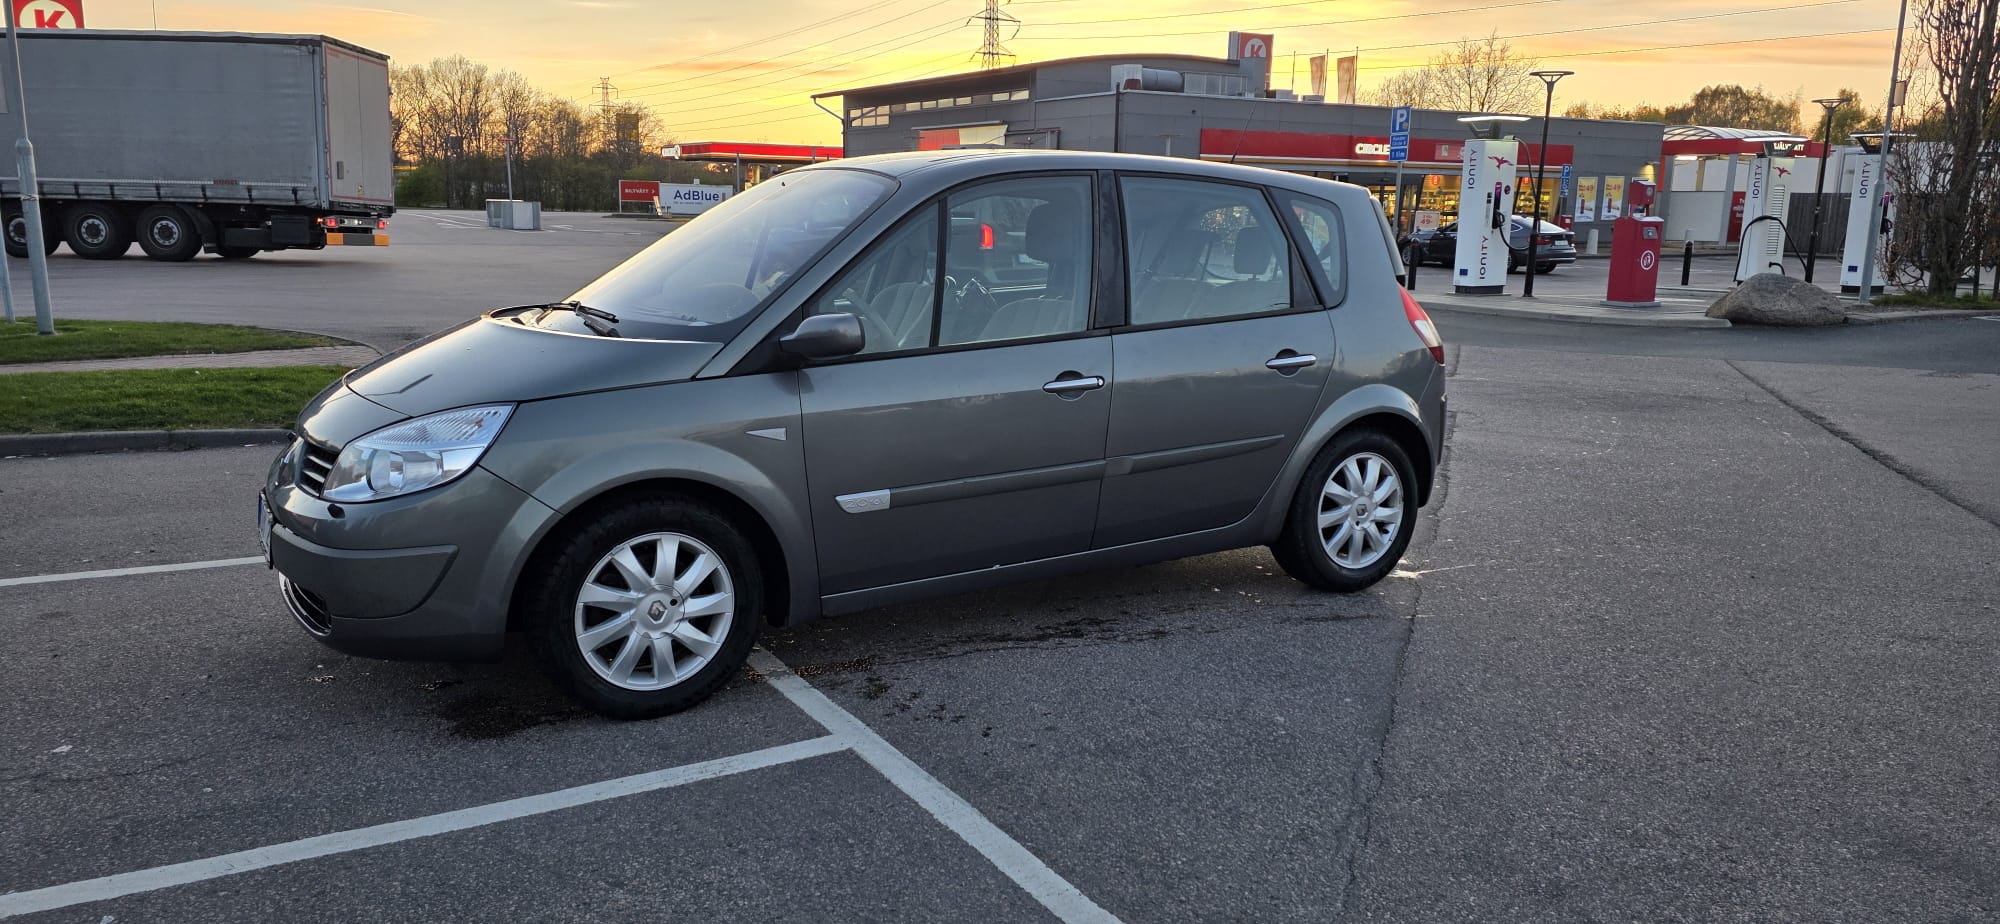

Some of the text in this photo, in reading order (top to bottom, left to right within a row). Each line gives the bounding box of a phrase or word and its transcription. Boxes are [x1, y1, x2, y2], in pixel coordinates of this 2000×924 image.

[34, 9, 66, 28] K
[1250, 44, 1263, 57] K
[1395, 108, 1408, 131] P
[1355, 143, 1390, 154] CIRCLE
[1468, 148, 1477, 189] IONITY
[1859, 161, 1871, 199] IONITY
[1752, 164, 1762, 199] IONITY
[673, 189, 720, 201] AdBlue
[1479, 235, 1489, 279] IONITY
